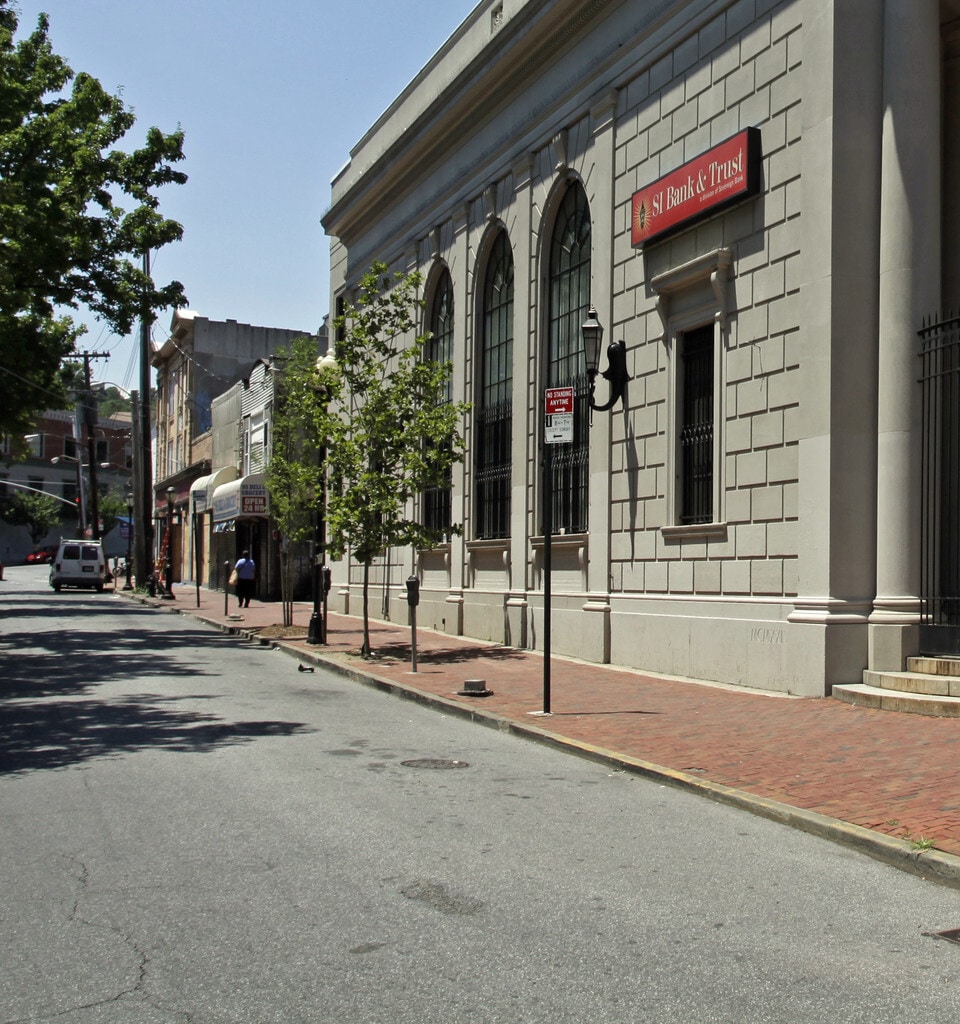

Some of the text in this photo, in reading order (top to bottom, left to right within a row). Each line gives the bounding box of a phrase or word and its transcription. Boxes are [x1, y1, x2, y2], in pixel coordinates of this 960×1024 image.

[652, 147, 743, 217] SI Bank & Trust
[734, 174, 744, 185] Bank
[553, 390, 571, 398] STANDING
